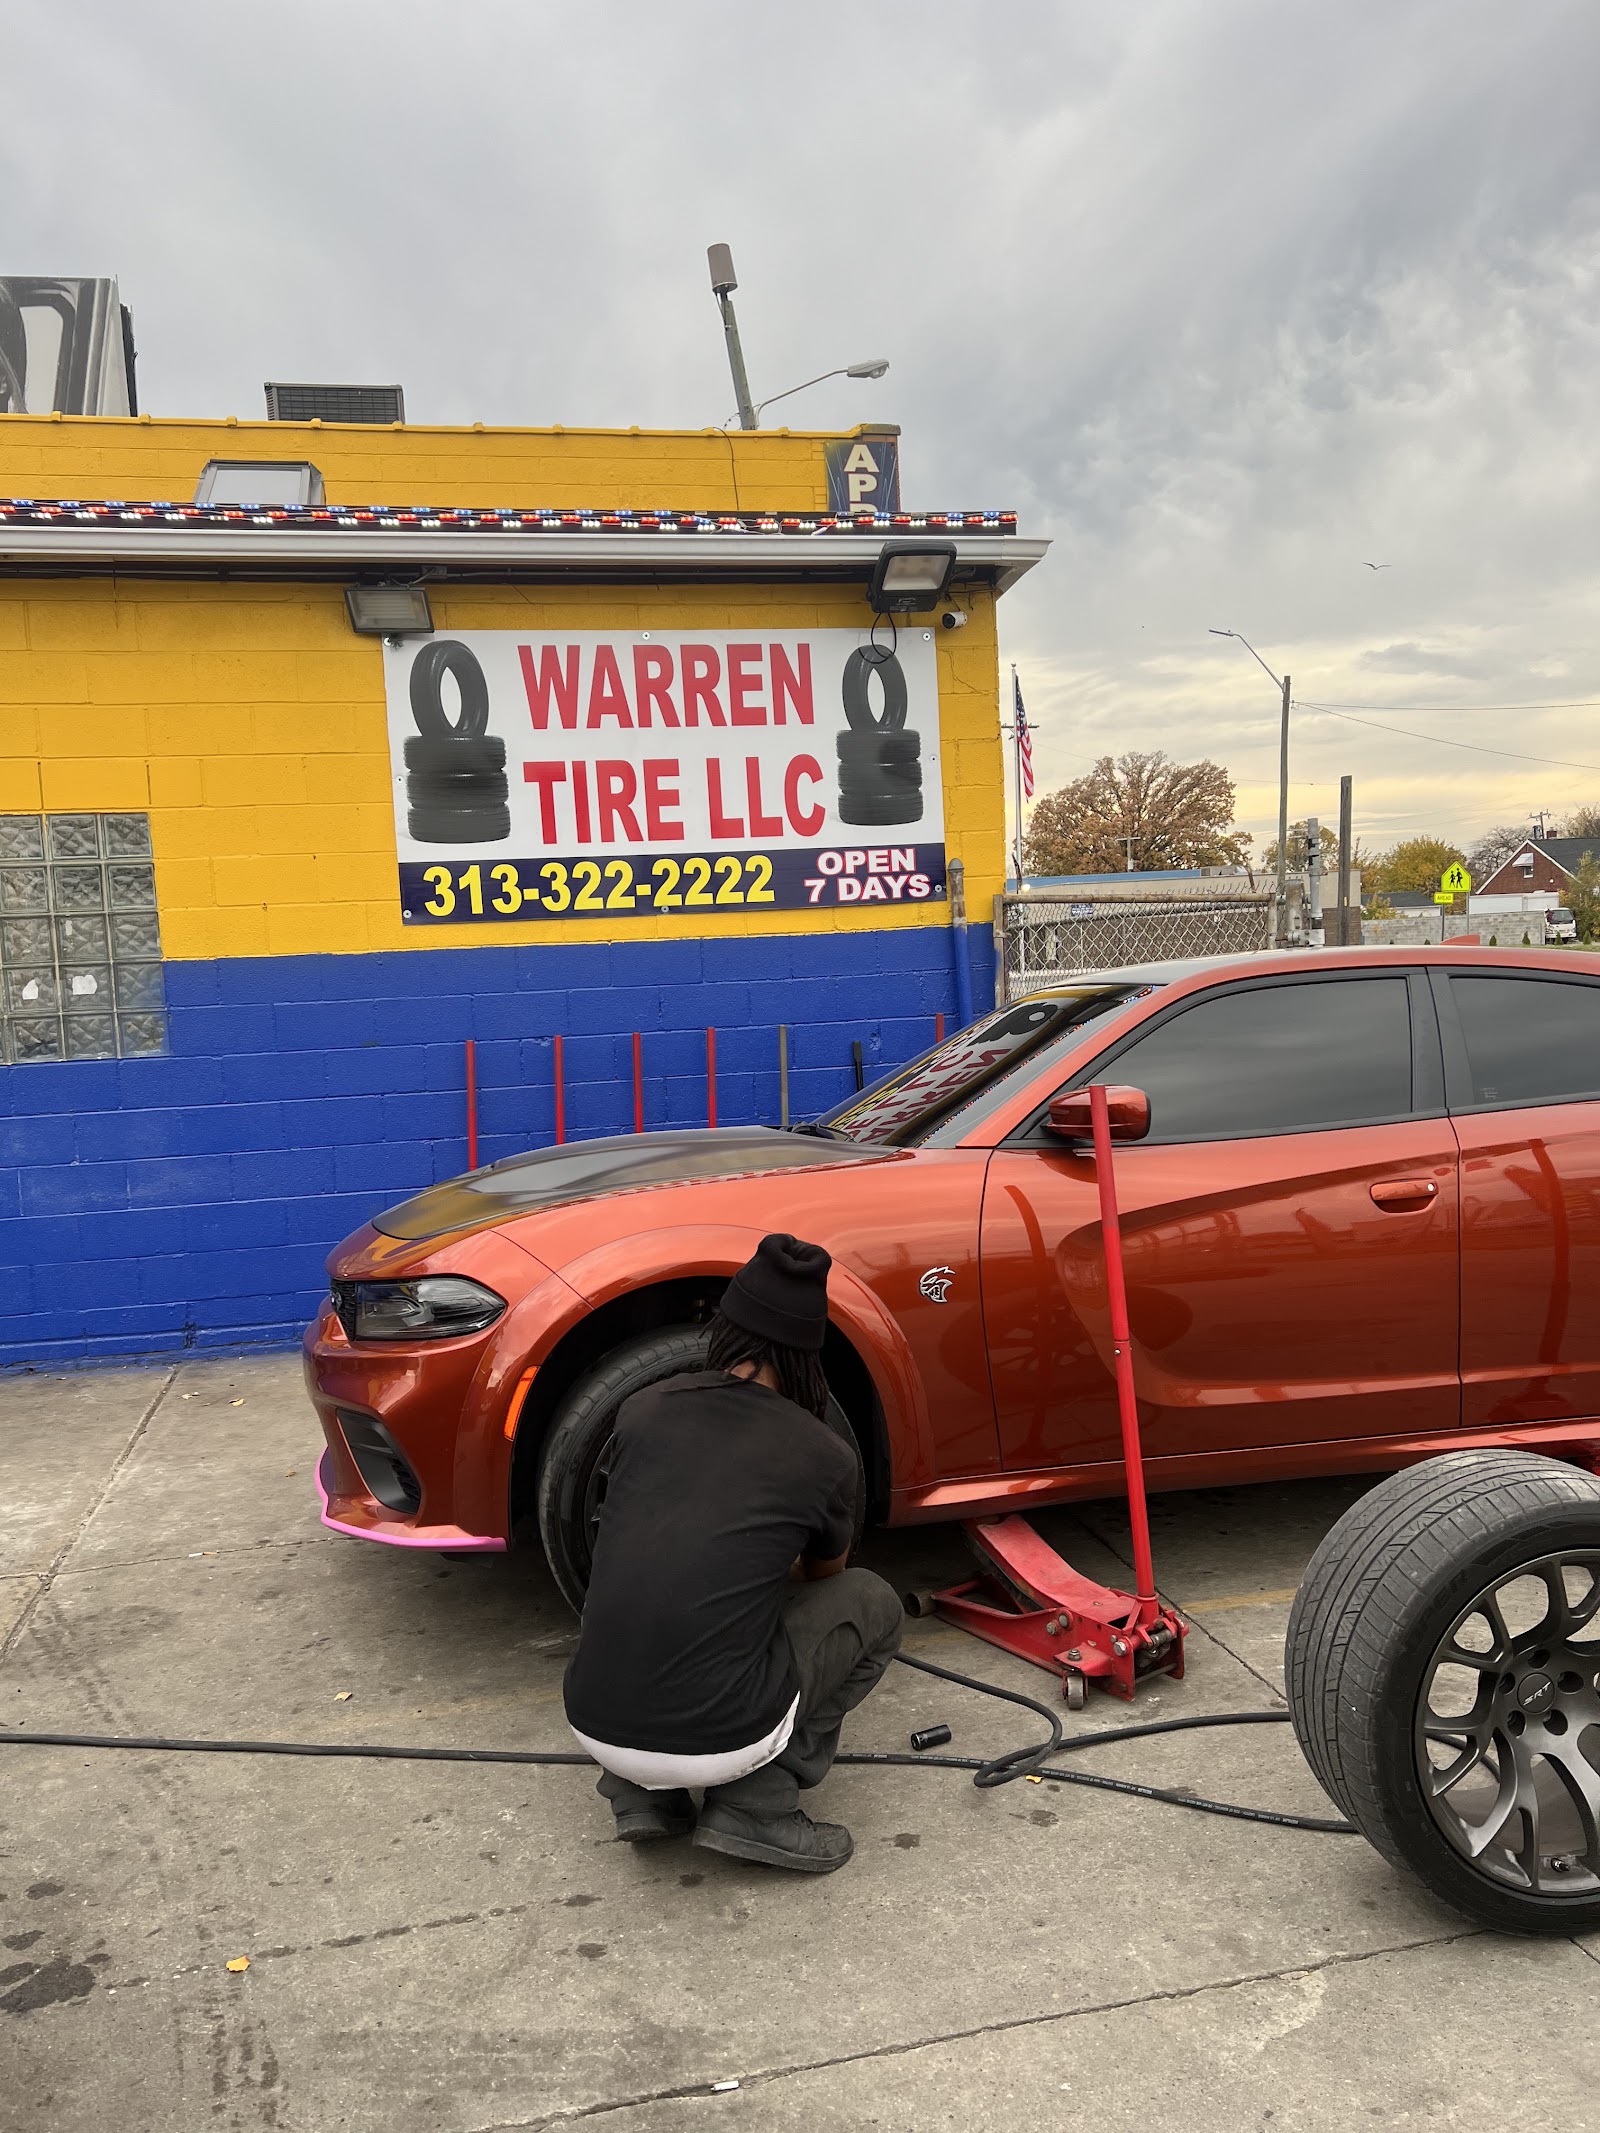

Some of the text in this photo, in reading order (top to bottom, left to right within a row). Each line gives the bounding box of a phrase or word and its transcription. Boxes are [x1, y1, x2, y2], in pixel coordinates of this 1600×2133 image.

[517, 643, 815, 730] WARREN
[523, 753, 827, 845] TIRE LLC
[818, 847, 916, 875] OPEN
[422, 854, 776, 917] 313-322-2222
[804, 873, 931, 903] 7 DAYS
[1523, 1681, 1551, 1706] SRT
